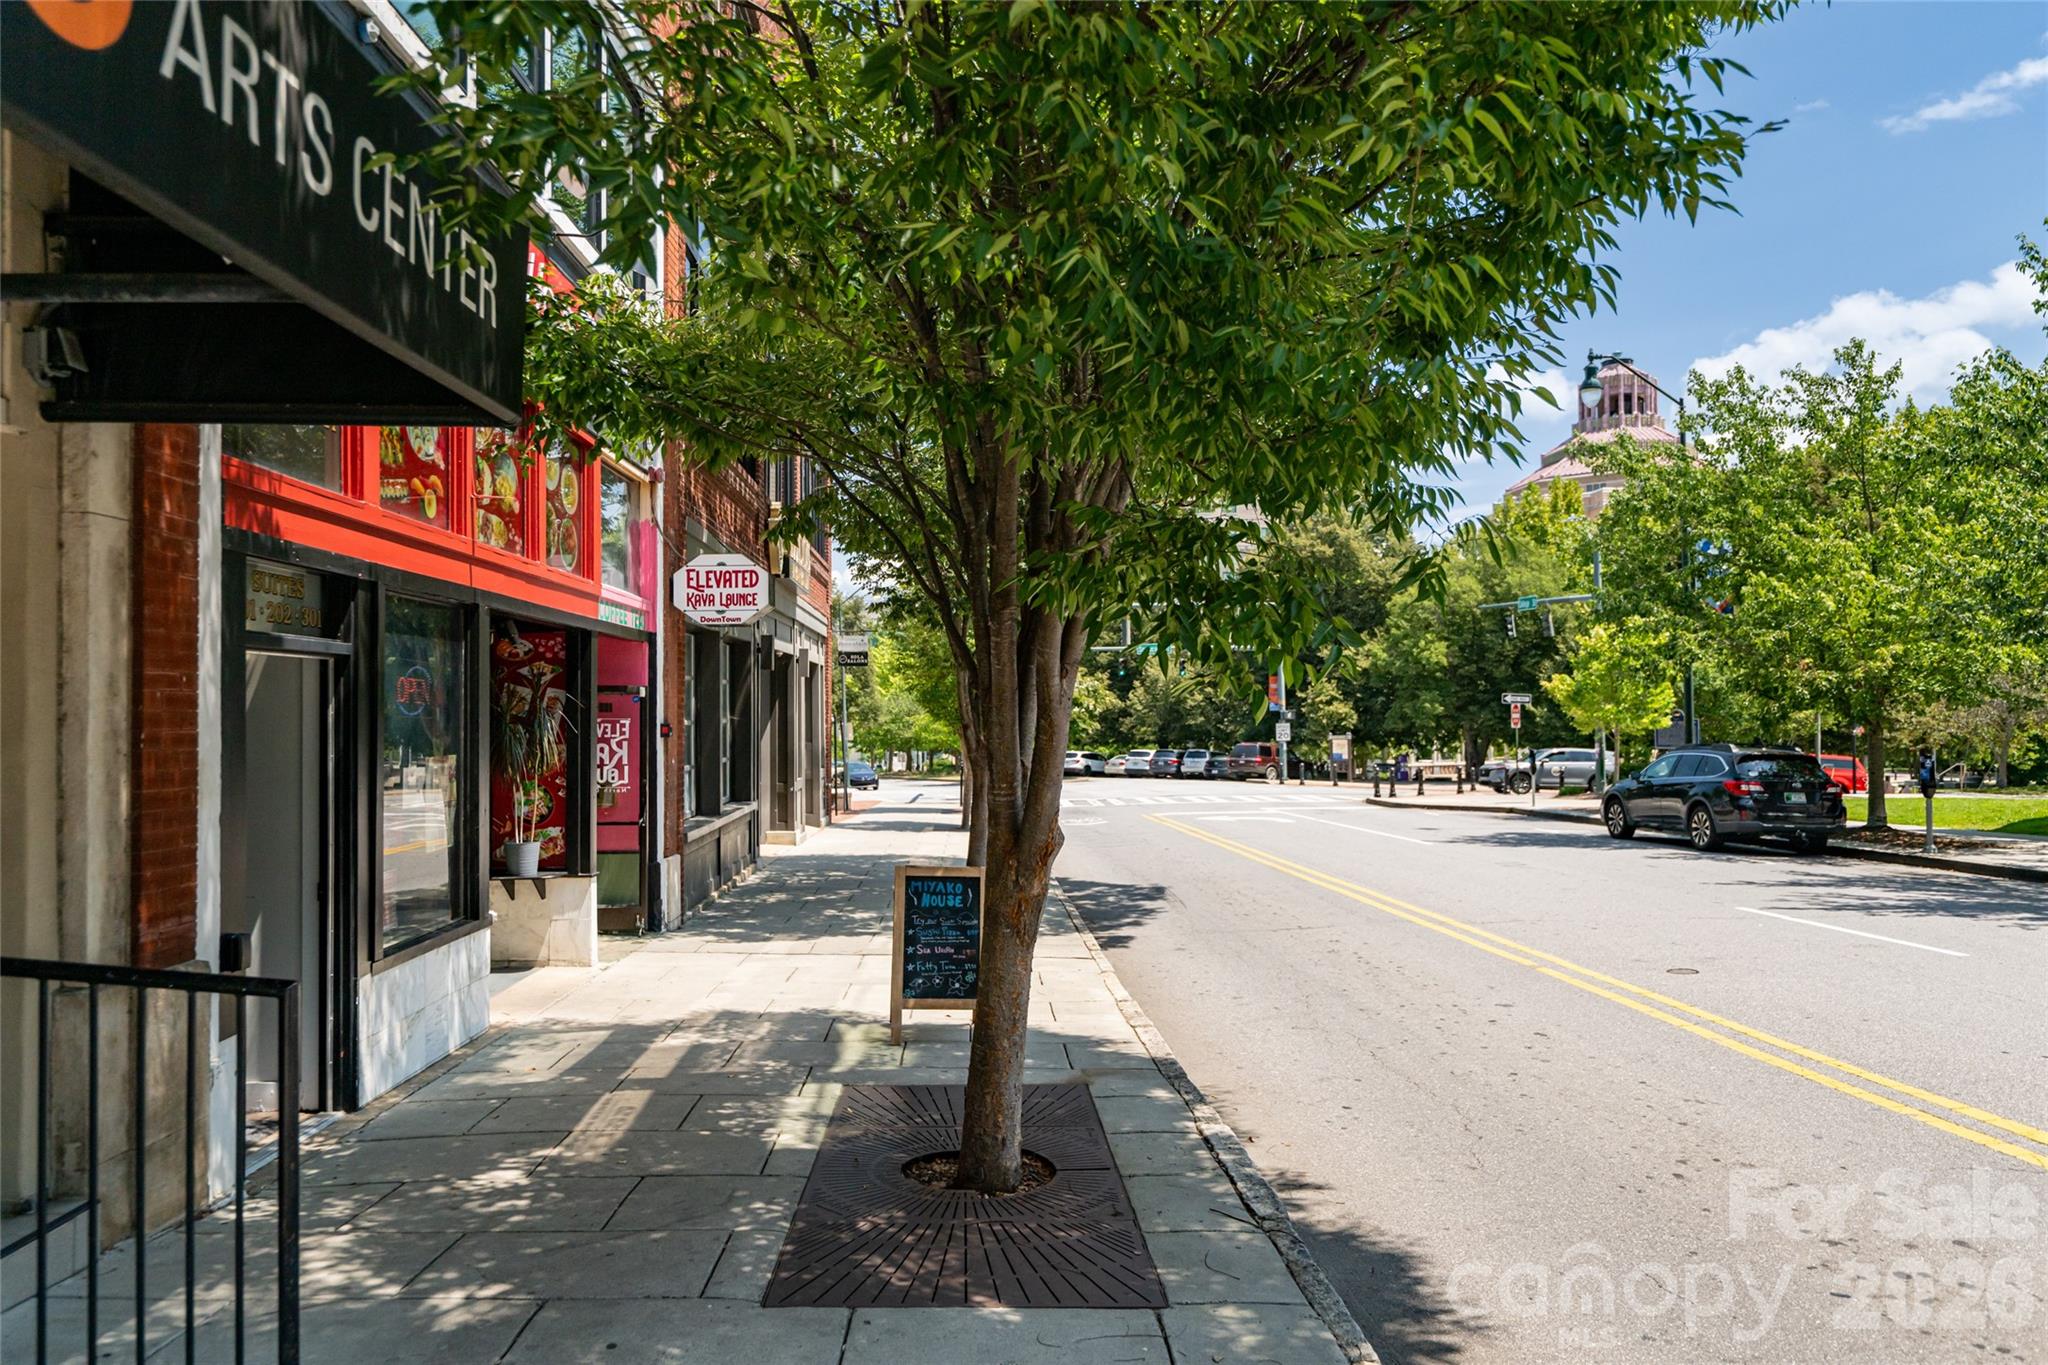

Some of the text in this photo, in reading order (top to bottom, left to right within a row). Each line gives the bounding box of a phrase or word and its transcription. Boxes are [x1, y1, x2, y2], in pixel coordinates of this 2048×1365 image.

[159, 0, 497, 329] ARTS CENTER
[252, 569, 305, 600] SUITES
[686, 569, 759, 592] ELEVATED
[686, 592, 758, 609] KAVA LOUNGE
[266, 601, 292, 625] 202
[700, 615, 741, 623] DownTown
[396, 677, 430, 704] OPEN
[911, 881, 963, 894] MIYAKO
[921, 893, 963, 907] HOUSE
